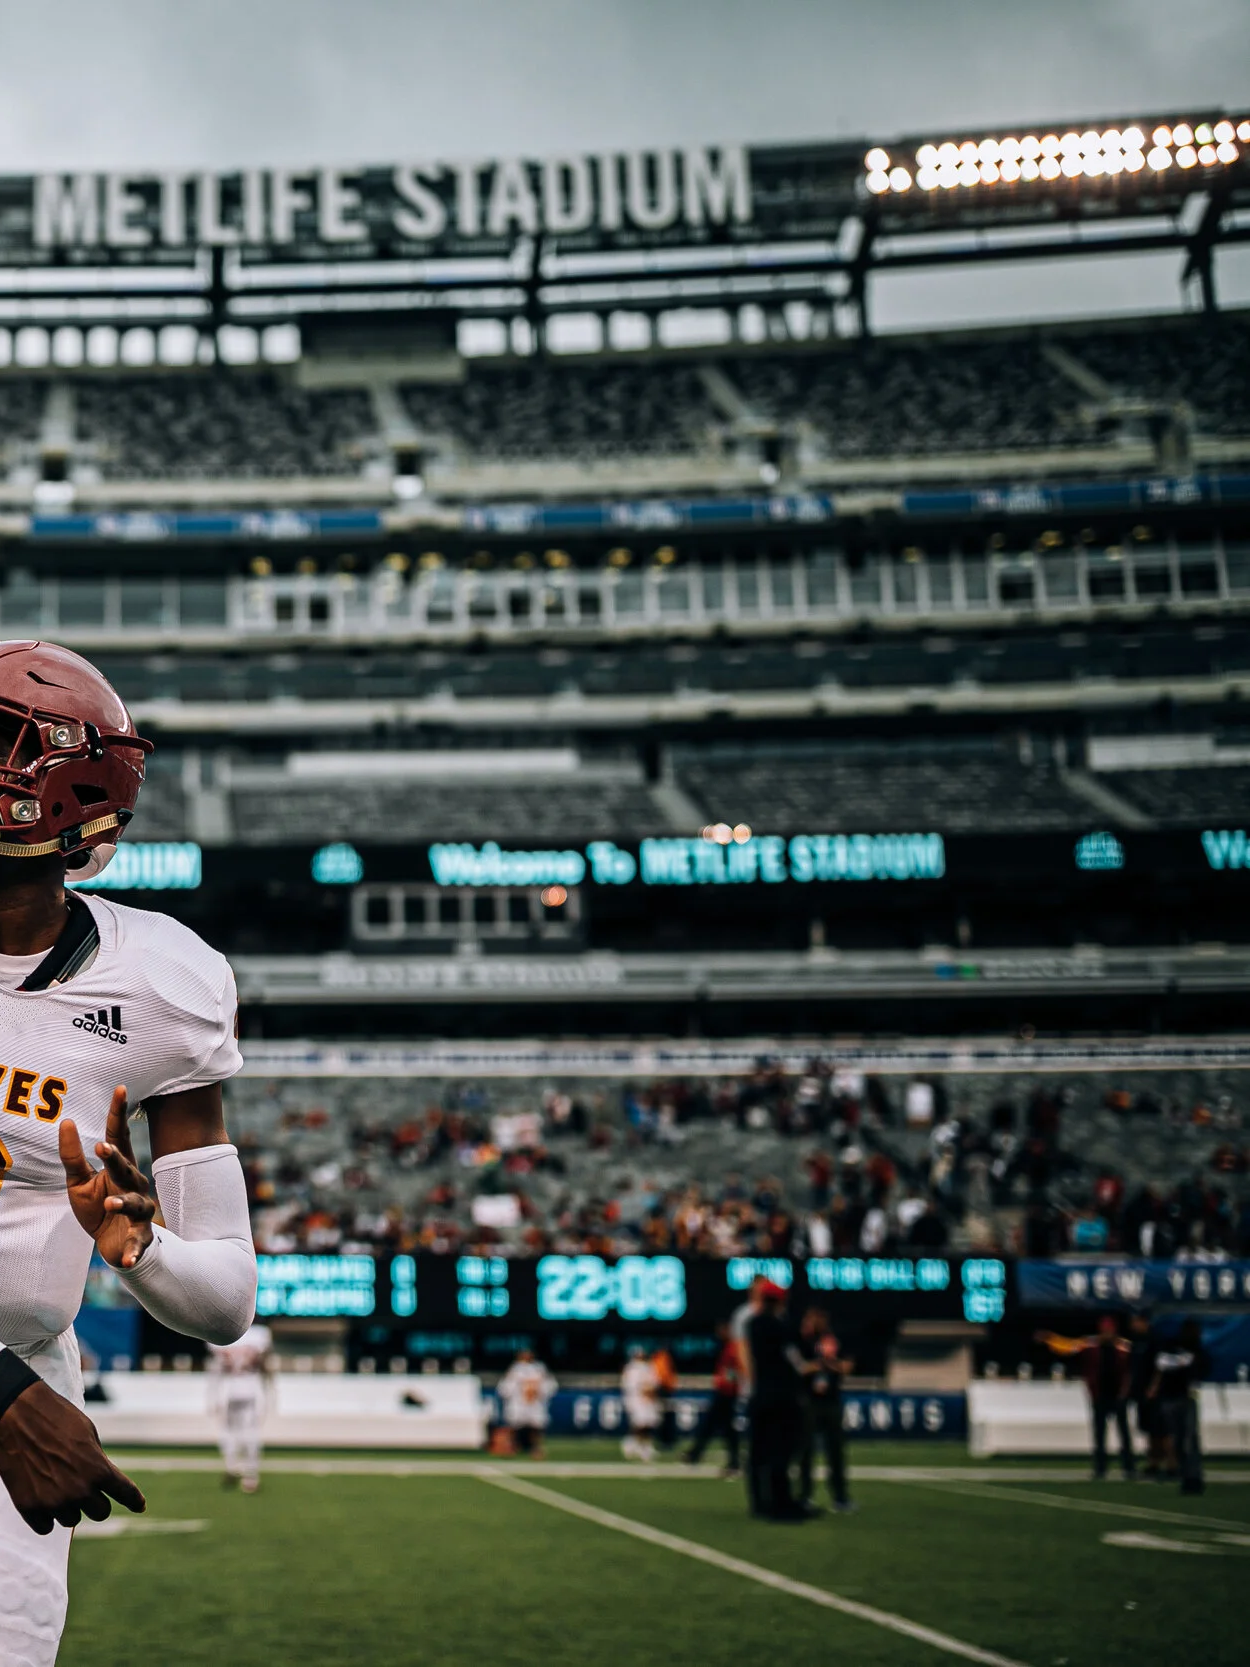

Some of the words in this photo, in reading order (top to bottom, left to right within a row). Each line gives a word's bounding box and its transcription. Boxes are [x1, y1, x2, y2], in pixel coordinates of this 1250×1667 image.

[33, 168, 370, 250] METLIFE
[388, 144, 751, 240] STADIUM
[428, 841, 585, 887] Welcome
[586, 841, 636, 884] To
[640, 836, 786, 884] METLIFE
[788, 832, 945, 882] STADIUM
[72, 1017, 128, 1045] adidas
[1066, 1269, 1145, 1299] NEW
